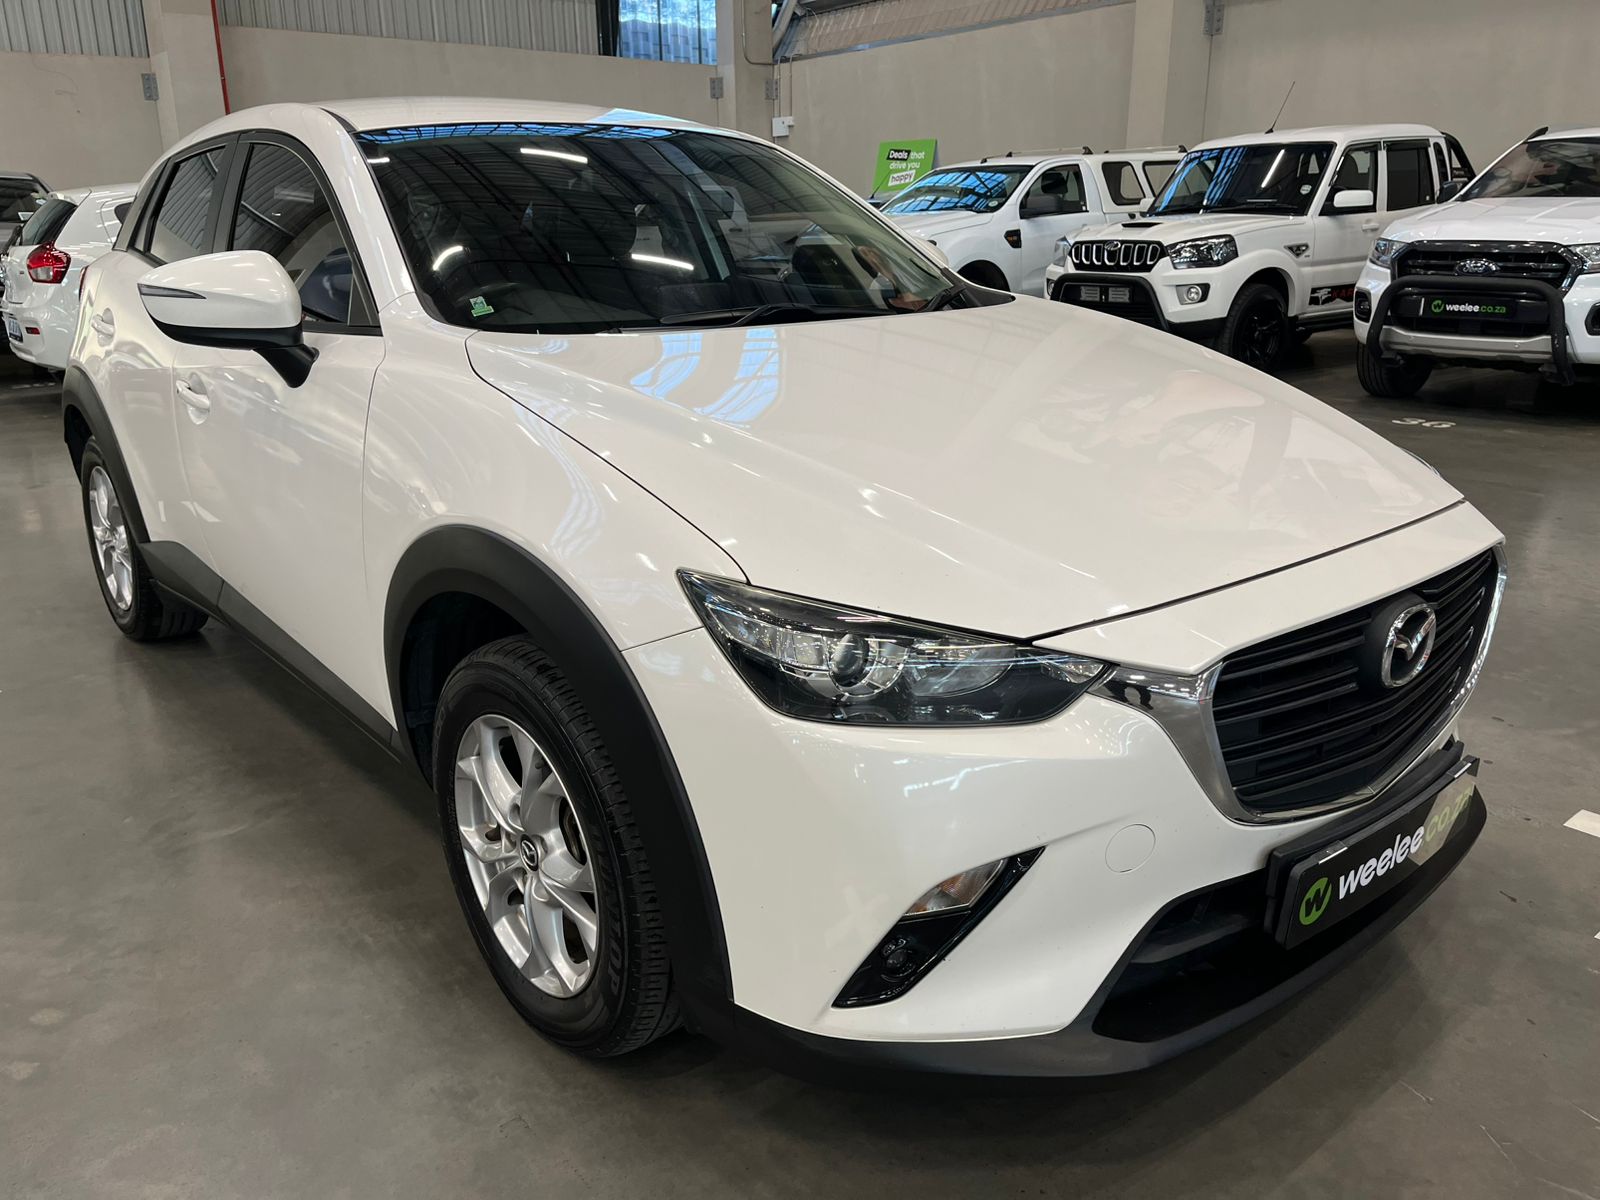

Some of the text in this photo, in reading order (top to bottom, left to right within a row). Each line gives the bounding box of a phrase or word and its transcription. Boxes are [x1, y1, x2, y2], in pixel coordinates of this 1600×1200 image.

[889, 150, 925, 159] Deals that
[889, 161, 921, 170] drive you
[891, 172, 913, 183] happy
[1445, 303, 1507, 313] weelee.co.za
[1391, 417, 1457, 428] 36
